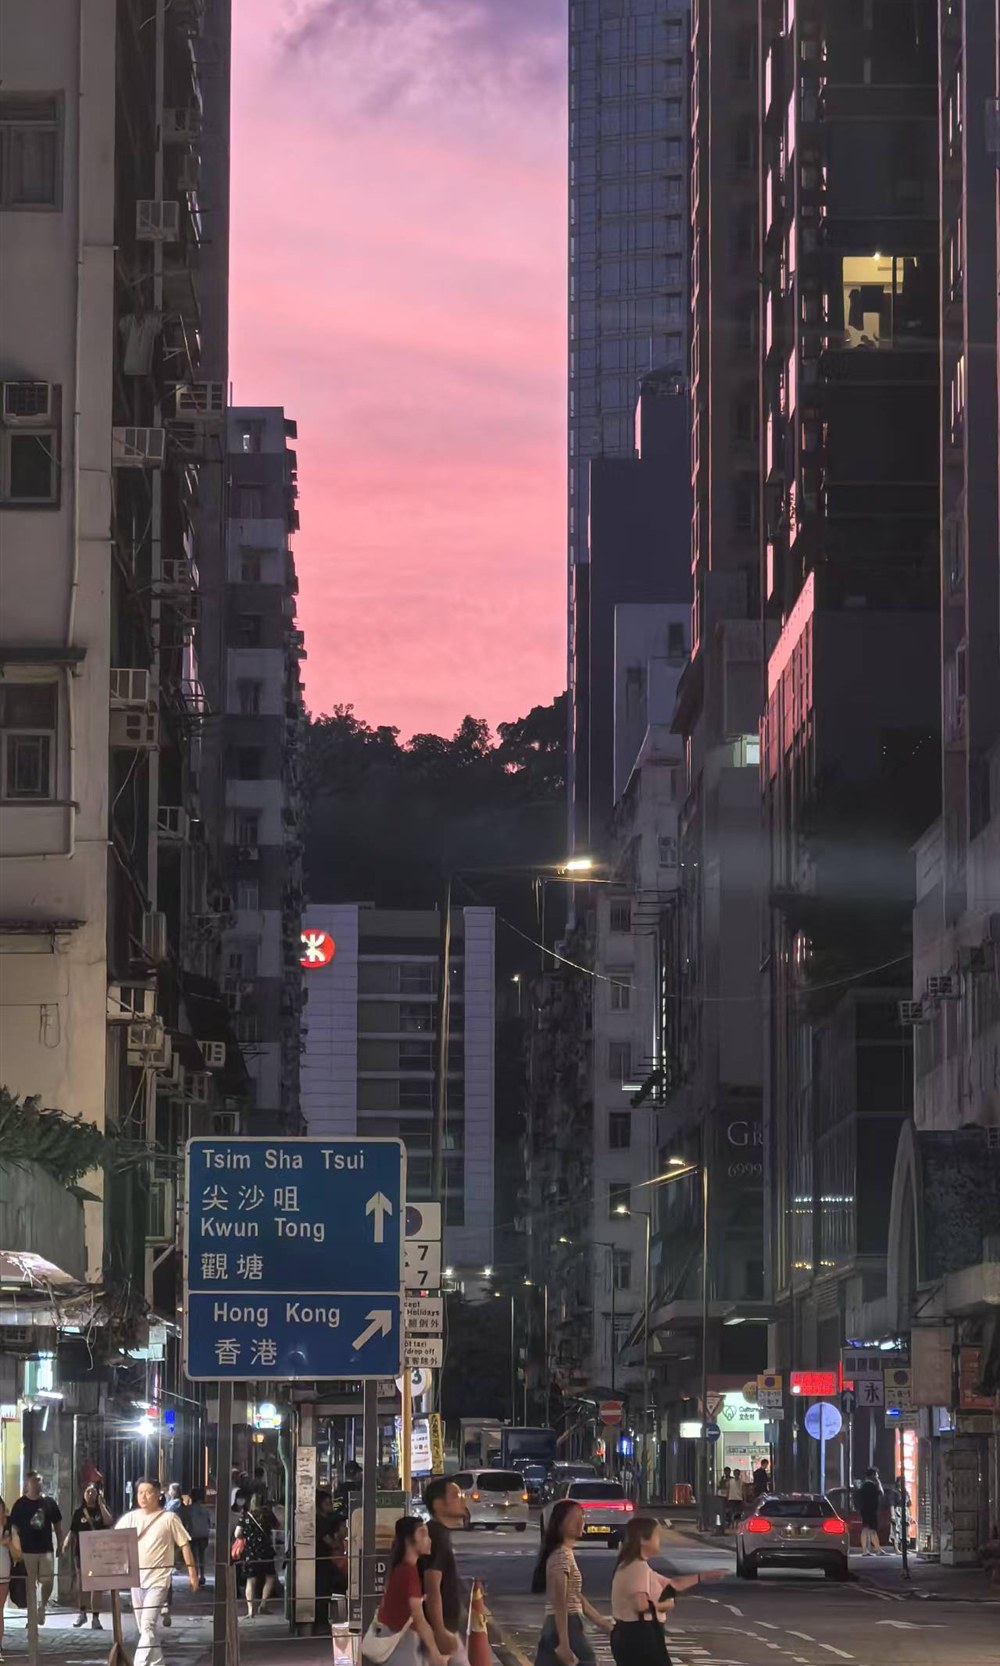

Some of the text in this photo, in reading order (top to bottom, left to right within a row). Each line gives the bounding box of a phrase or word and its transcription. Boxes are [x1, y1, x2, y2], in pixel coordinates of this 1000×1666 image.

[202, 1149, 364, 1169] Tsim Sha Tsui
[202, 1184, 300, 1212] 尖沙咀
[201, 1217, 325, 1243] Kwun Tong
[201, 1253, 263, 1280] 觀塘
[214, 1302, 340, 1328] Hong Kong
[407, 1308, 440, 1317] Holidays
[214, 1338, 277, 1366] 香港
[424, 1348, 435, 1356] off
